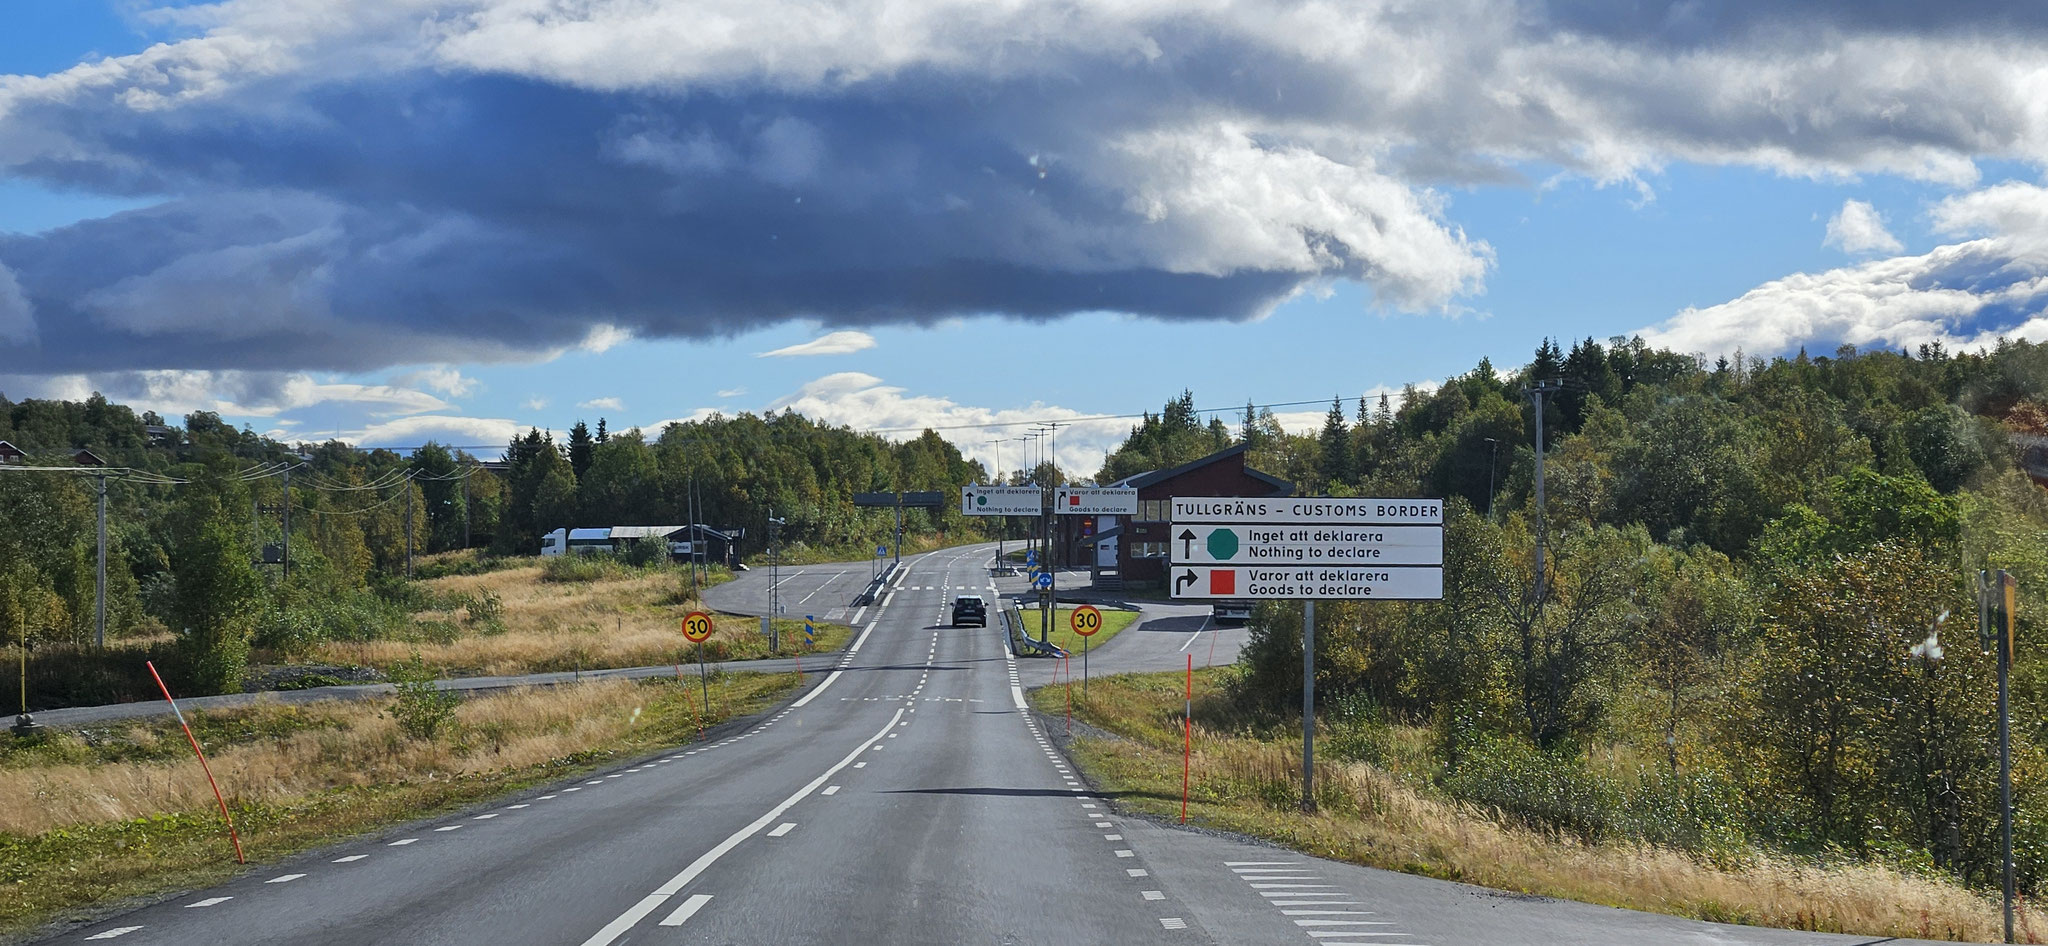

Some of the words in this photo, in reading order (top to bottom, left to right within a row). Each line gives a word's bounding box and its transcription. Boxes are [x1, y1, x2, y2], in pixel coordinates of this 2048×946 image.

[1176, 501, 1267, 516] TULLGRÄNS
[1293, 504, 1367, 517] CUSTOMS
[1377, 505, 1438, 517] BORDER
[1249, 530, 1284, 543] Inget
[1289, 530, 1308, 541] att
[1314, 530, 1383, 542] deklarera
[1249, 546, 1303, 560] Nothing
[1309, 547, 1322, 558] to
[1328, 547, 1380, 558] declare
[1249, 570, 1290, 581] Varor
[1295, 570, 1313, 581] att
[1320, 570, 1389, 582] deklarera
[1249, 584, 1294, 595] Goods
[1300, 584, 1313, 595] to
[1319, 584, 1372, 595] declare
[687, 619, 708, 635] 30
[1076, 613, 1097, 628] 30
